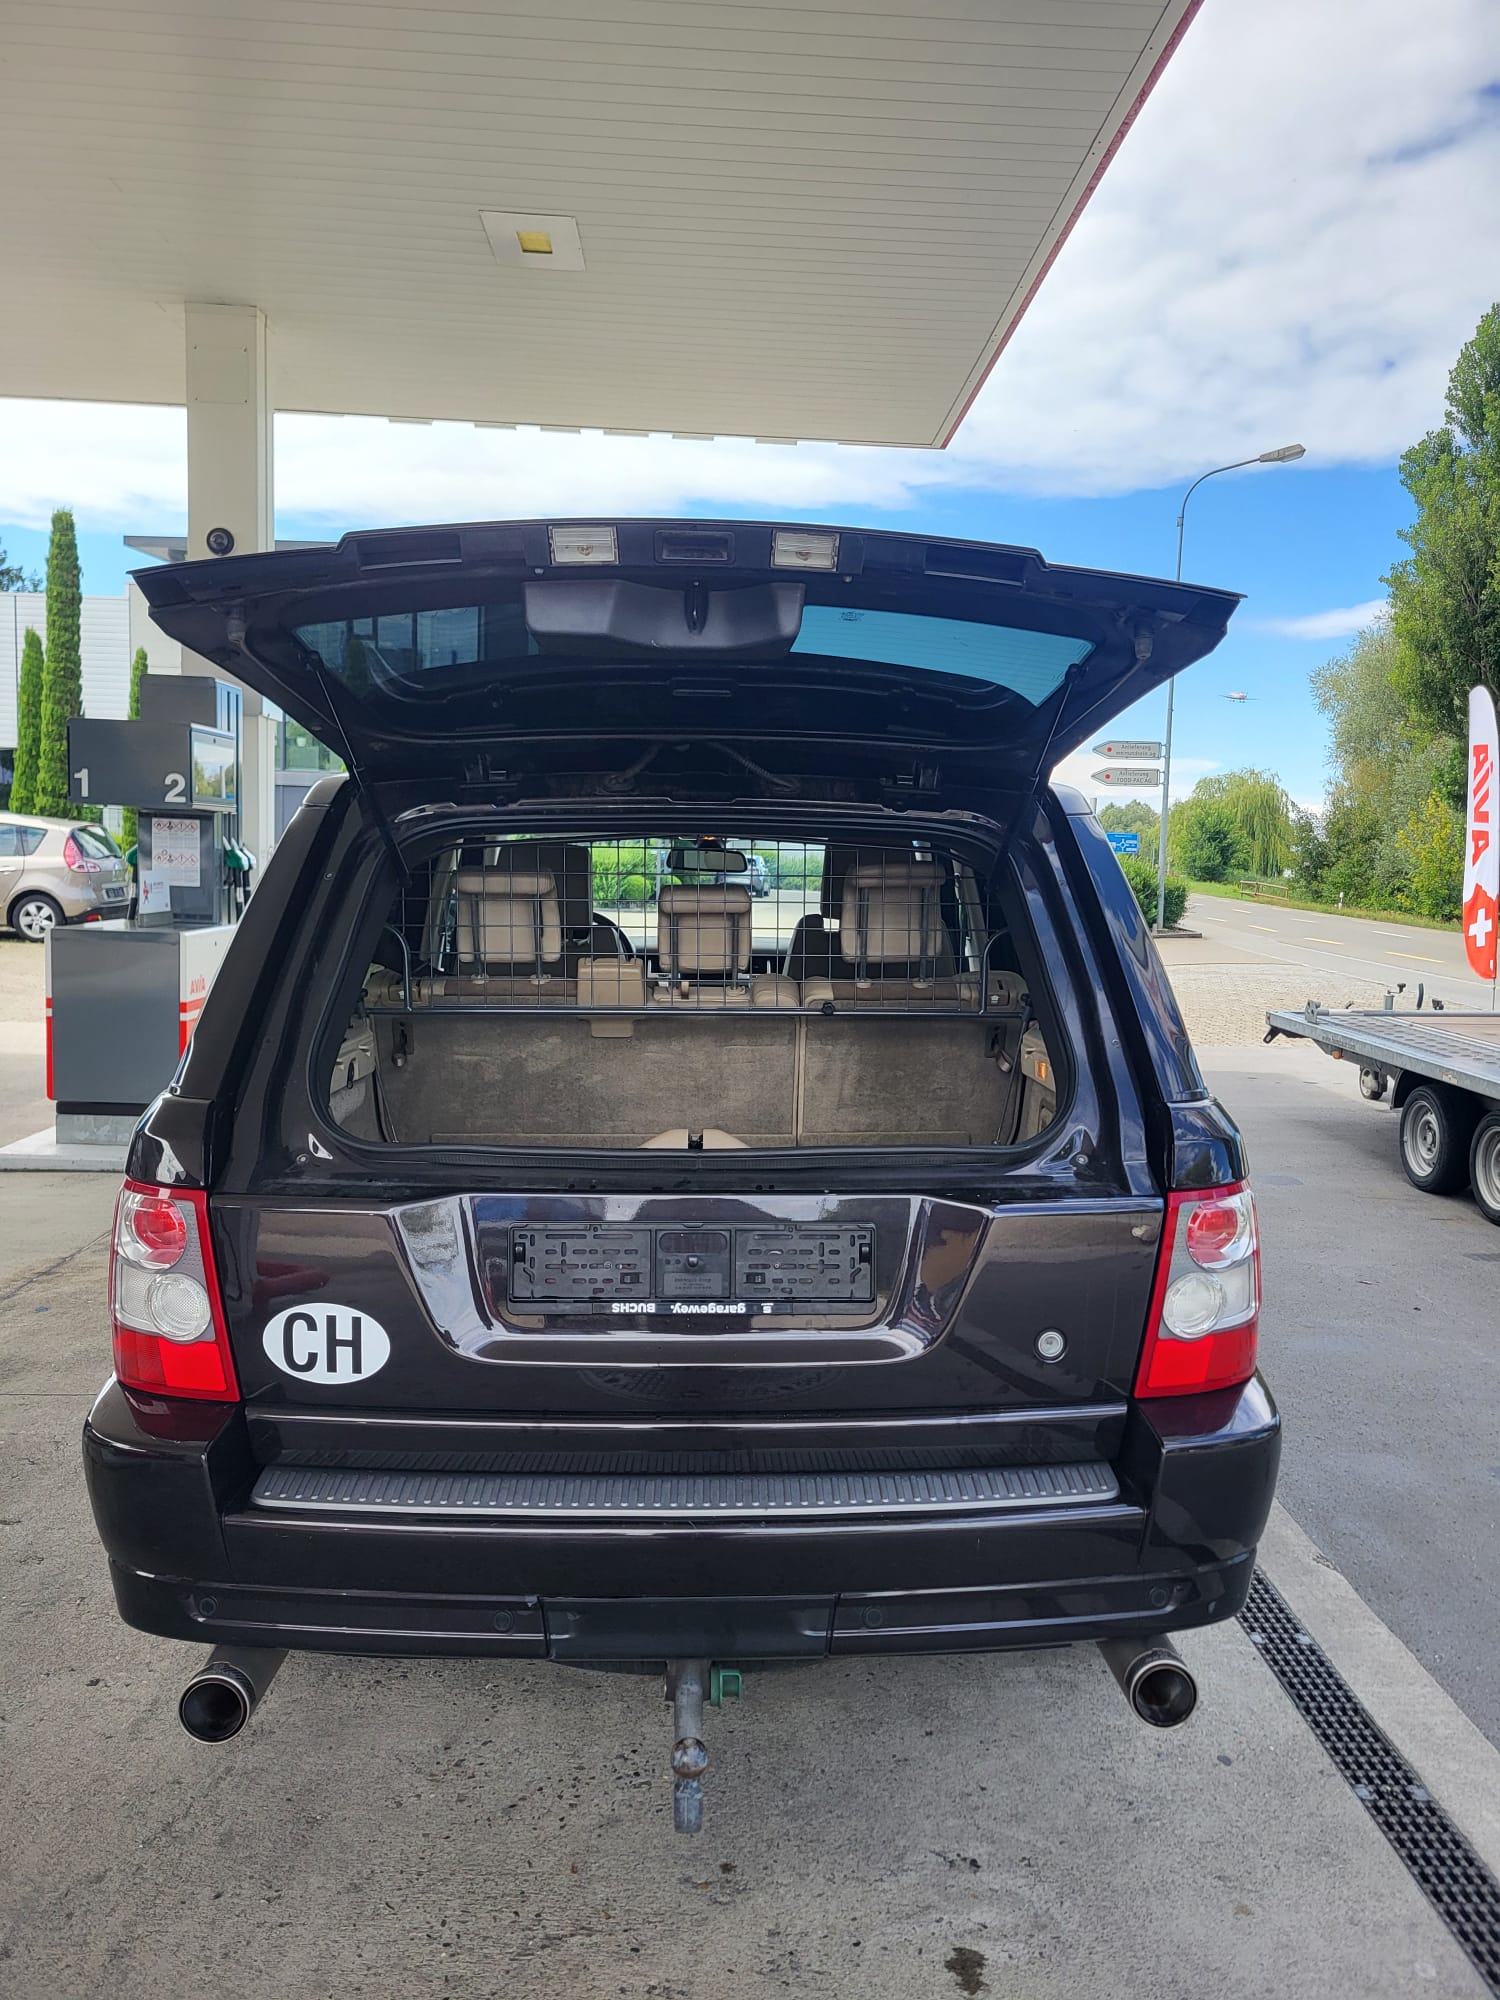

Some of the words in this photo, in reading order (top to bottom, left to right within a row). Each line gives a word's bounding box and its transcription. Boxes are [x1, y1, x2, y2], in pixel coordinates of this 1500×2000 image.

[74, 768, 89, 797] 1
[164, 773, 186, 803] 2
[612, 1303, 656, 1313] BUCHS
[670, 1303, 746, 1314] garagewey.
[282, 1311, 362, 1375] CH
